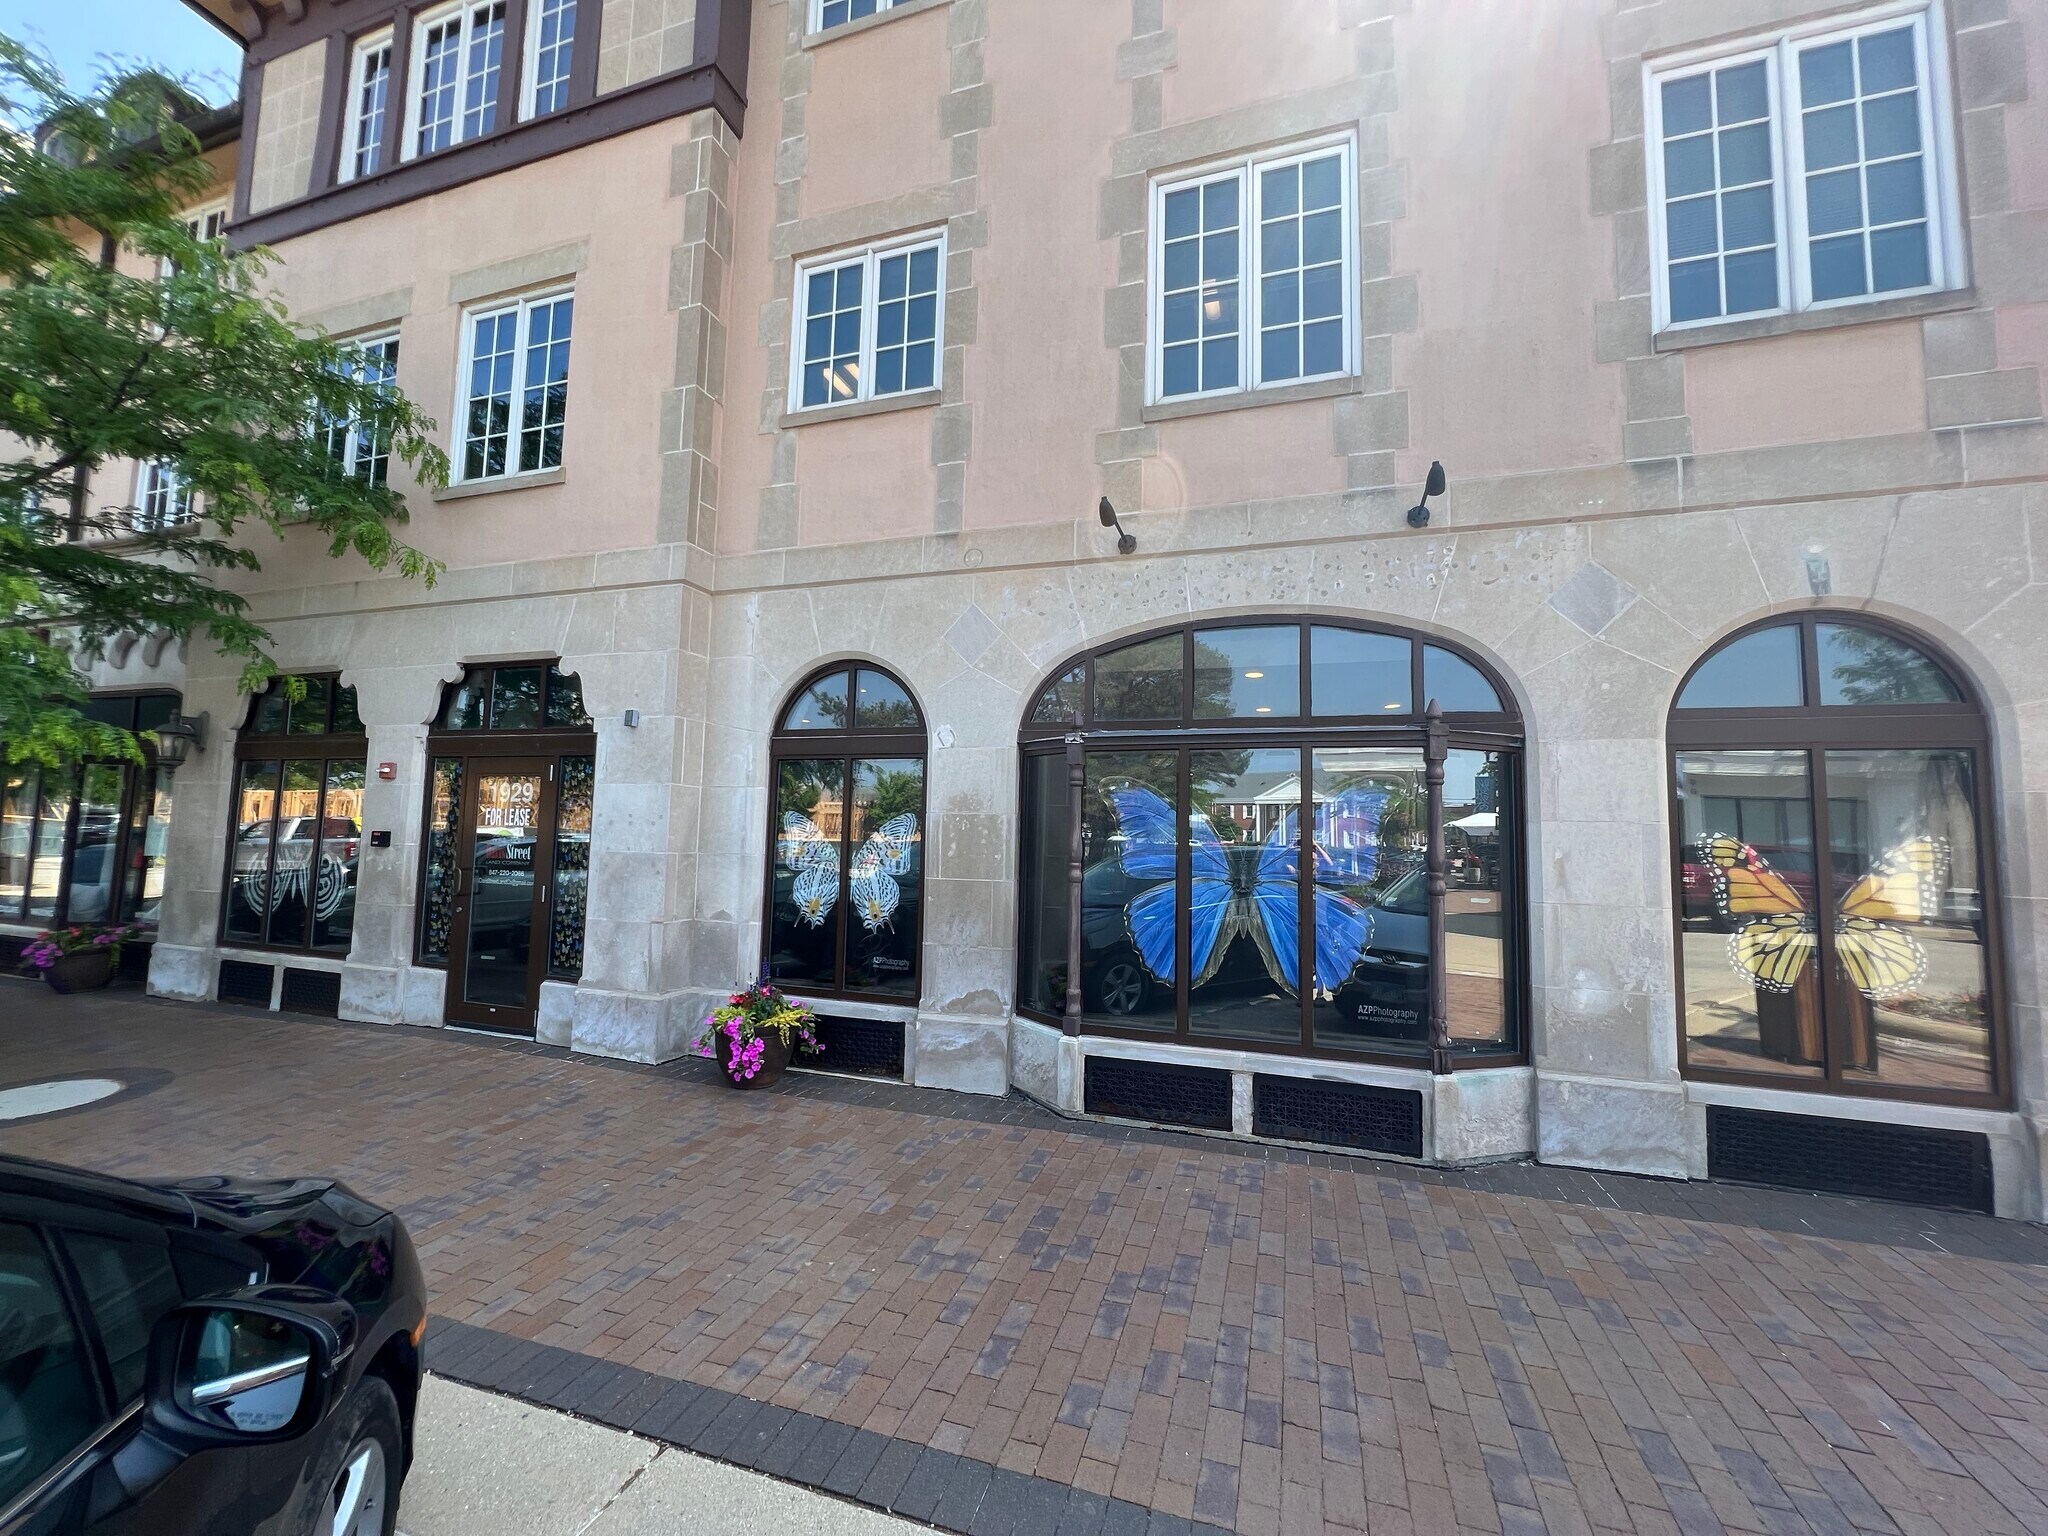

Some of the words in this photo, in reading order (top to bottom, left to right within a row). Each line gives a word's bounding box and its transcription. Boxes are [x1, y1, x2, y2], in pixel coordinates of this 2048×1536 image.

[489, 783, 533, 803] 1929
[485, 808, 502, 827] FOR
[504, 808, 530, 827] LEASE
[1358, 1005, 1419, 1020] AZPPhotography
